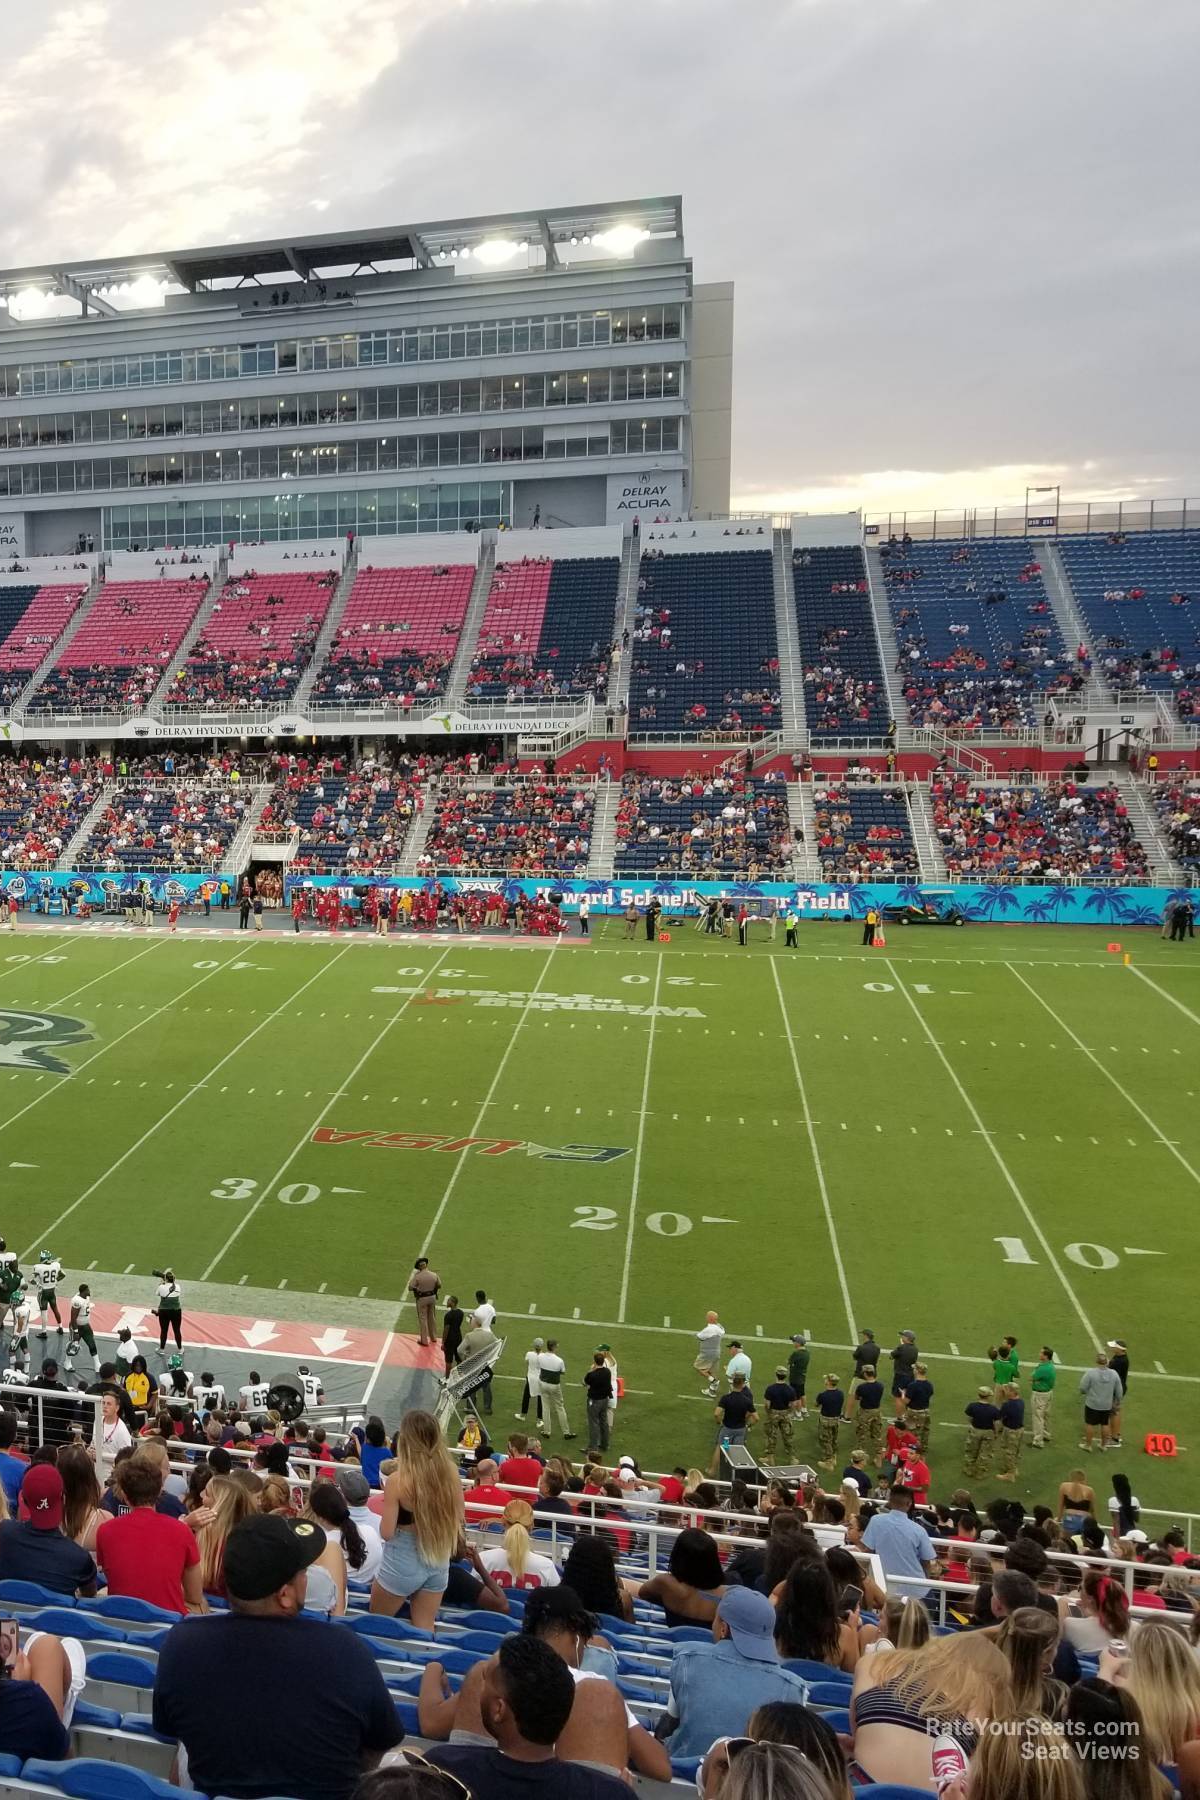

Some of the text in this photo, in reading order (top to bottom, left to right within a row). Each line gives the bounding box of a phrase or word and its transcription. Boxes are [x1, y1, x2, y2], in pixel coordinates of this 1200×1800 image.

[622, 485, 667, 497] DELRAY
[617, 498, 671, 510] ACURA
[155, 725, 274, 736] DELRAY HYUNDAI DECK
[455, 720, 570, 731] DELRAY HYUNDAI DECK
[796, 890, 850, 910] Field
[4, 953, 68, 964] 50
[192, 960, 258, 970] 40
[397, 966, 467, 978] 30
[620, 974, 696, 986] 20
[863, 982, 936, 994] 10
[210, 1177, 321, 1205] 30
[569, 1205, 694, 1237] 20
[992, 1235, 1122, 1270] 10
[43, 1270, 56, 1284] 26
[253, 1391, 268, 1407] 62
[1151, 1436, 1173, 1453] 10
